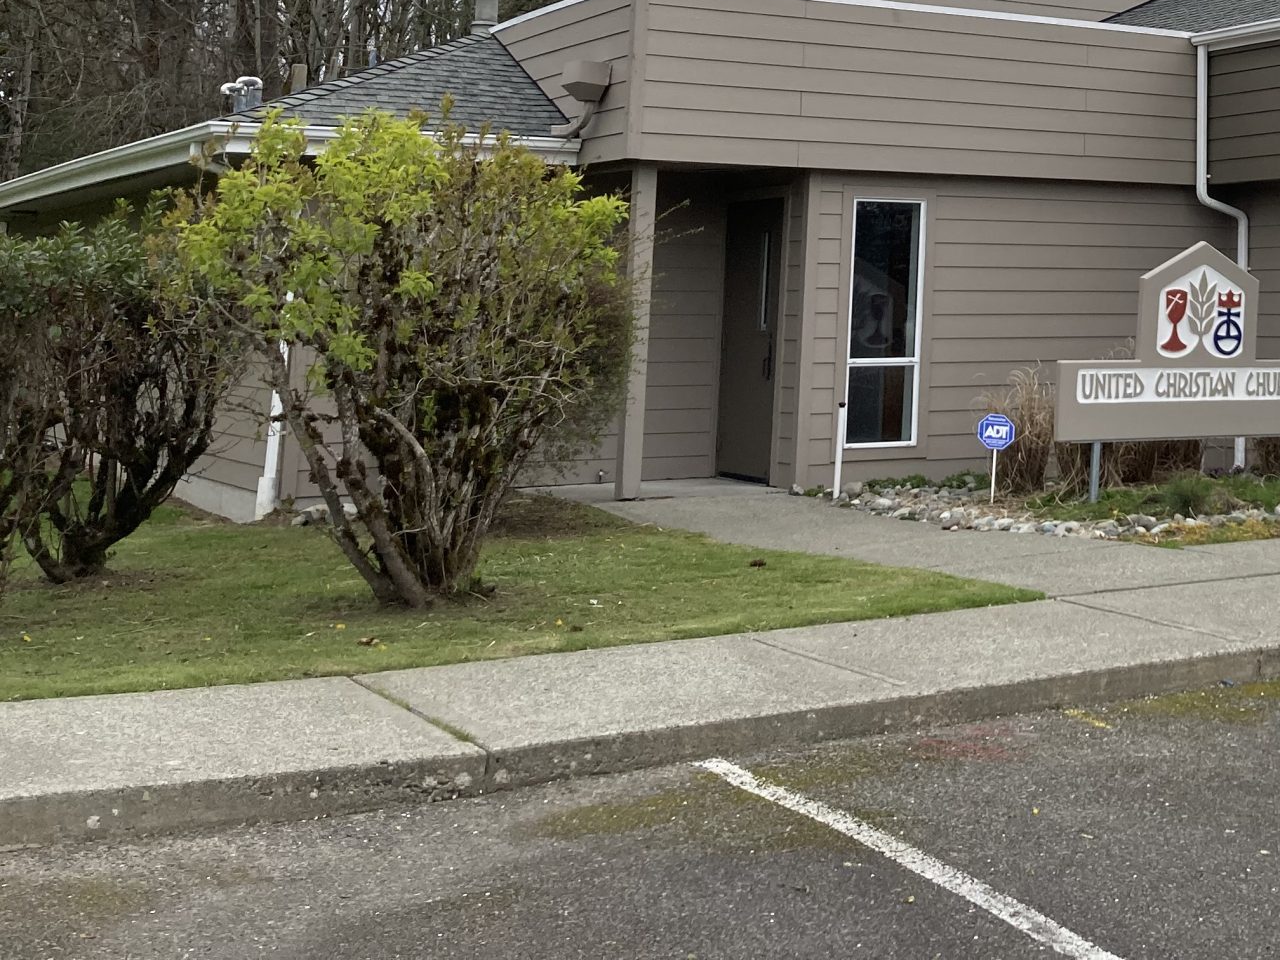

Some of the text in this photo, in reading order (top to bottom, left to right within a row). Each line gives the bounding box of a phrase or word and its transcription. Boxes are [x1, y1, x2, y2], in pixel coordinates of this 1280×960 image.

[1081, 371, 1145, 400] UNITED
[1155, 371, 1236, 398] CHRISTIAN
[983, 424, 1010, 439] ADT
